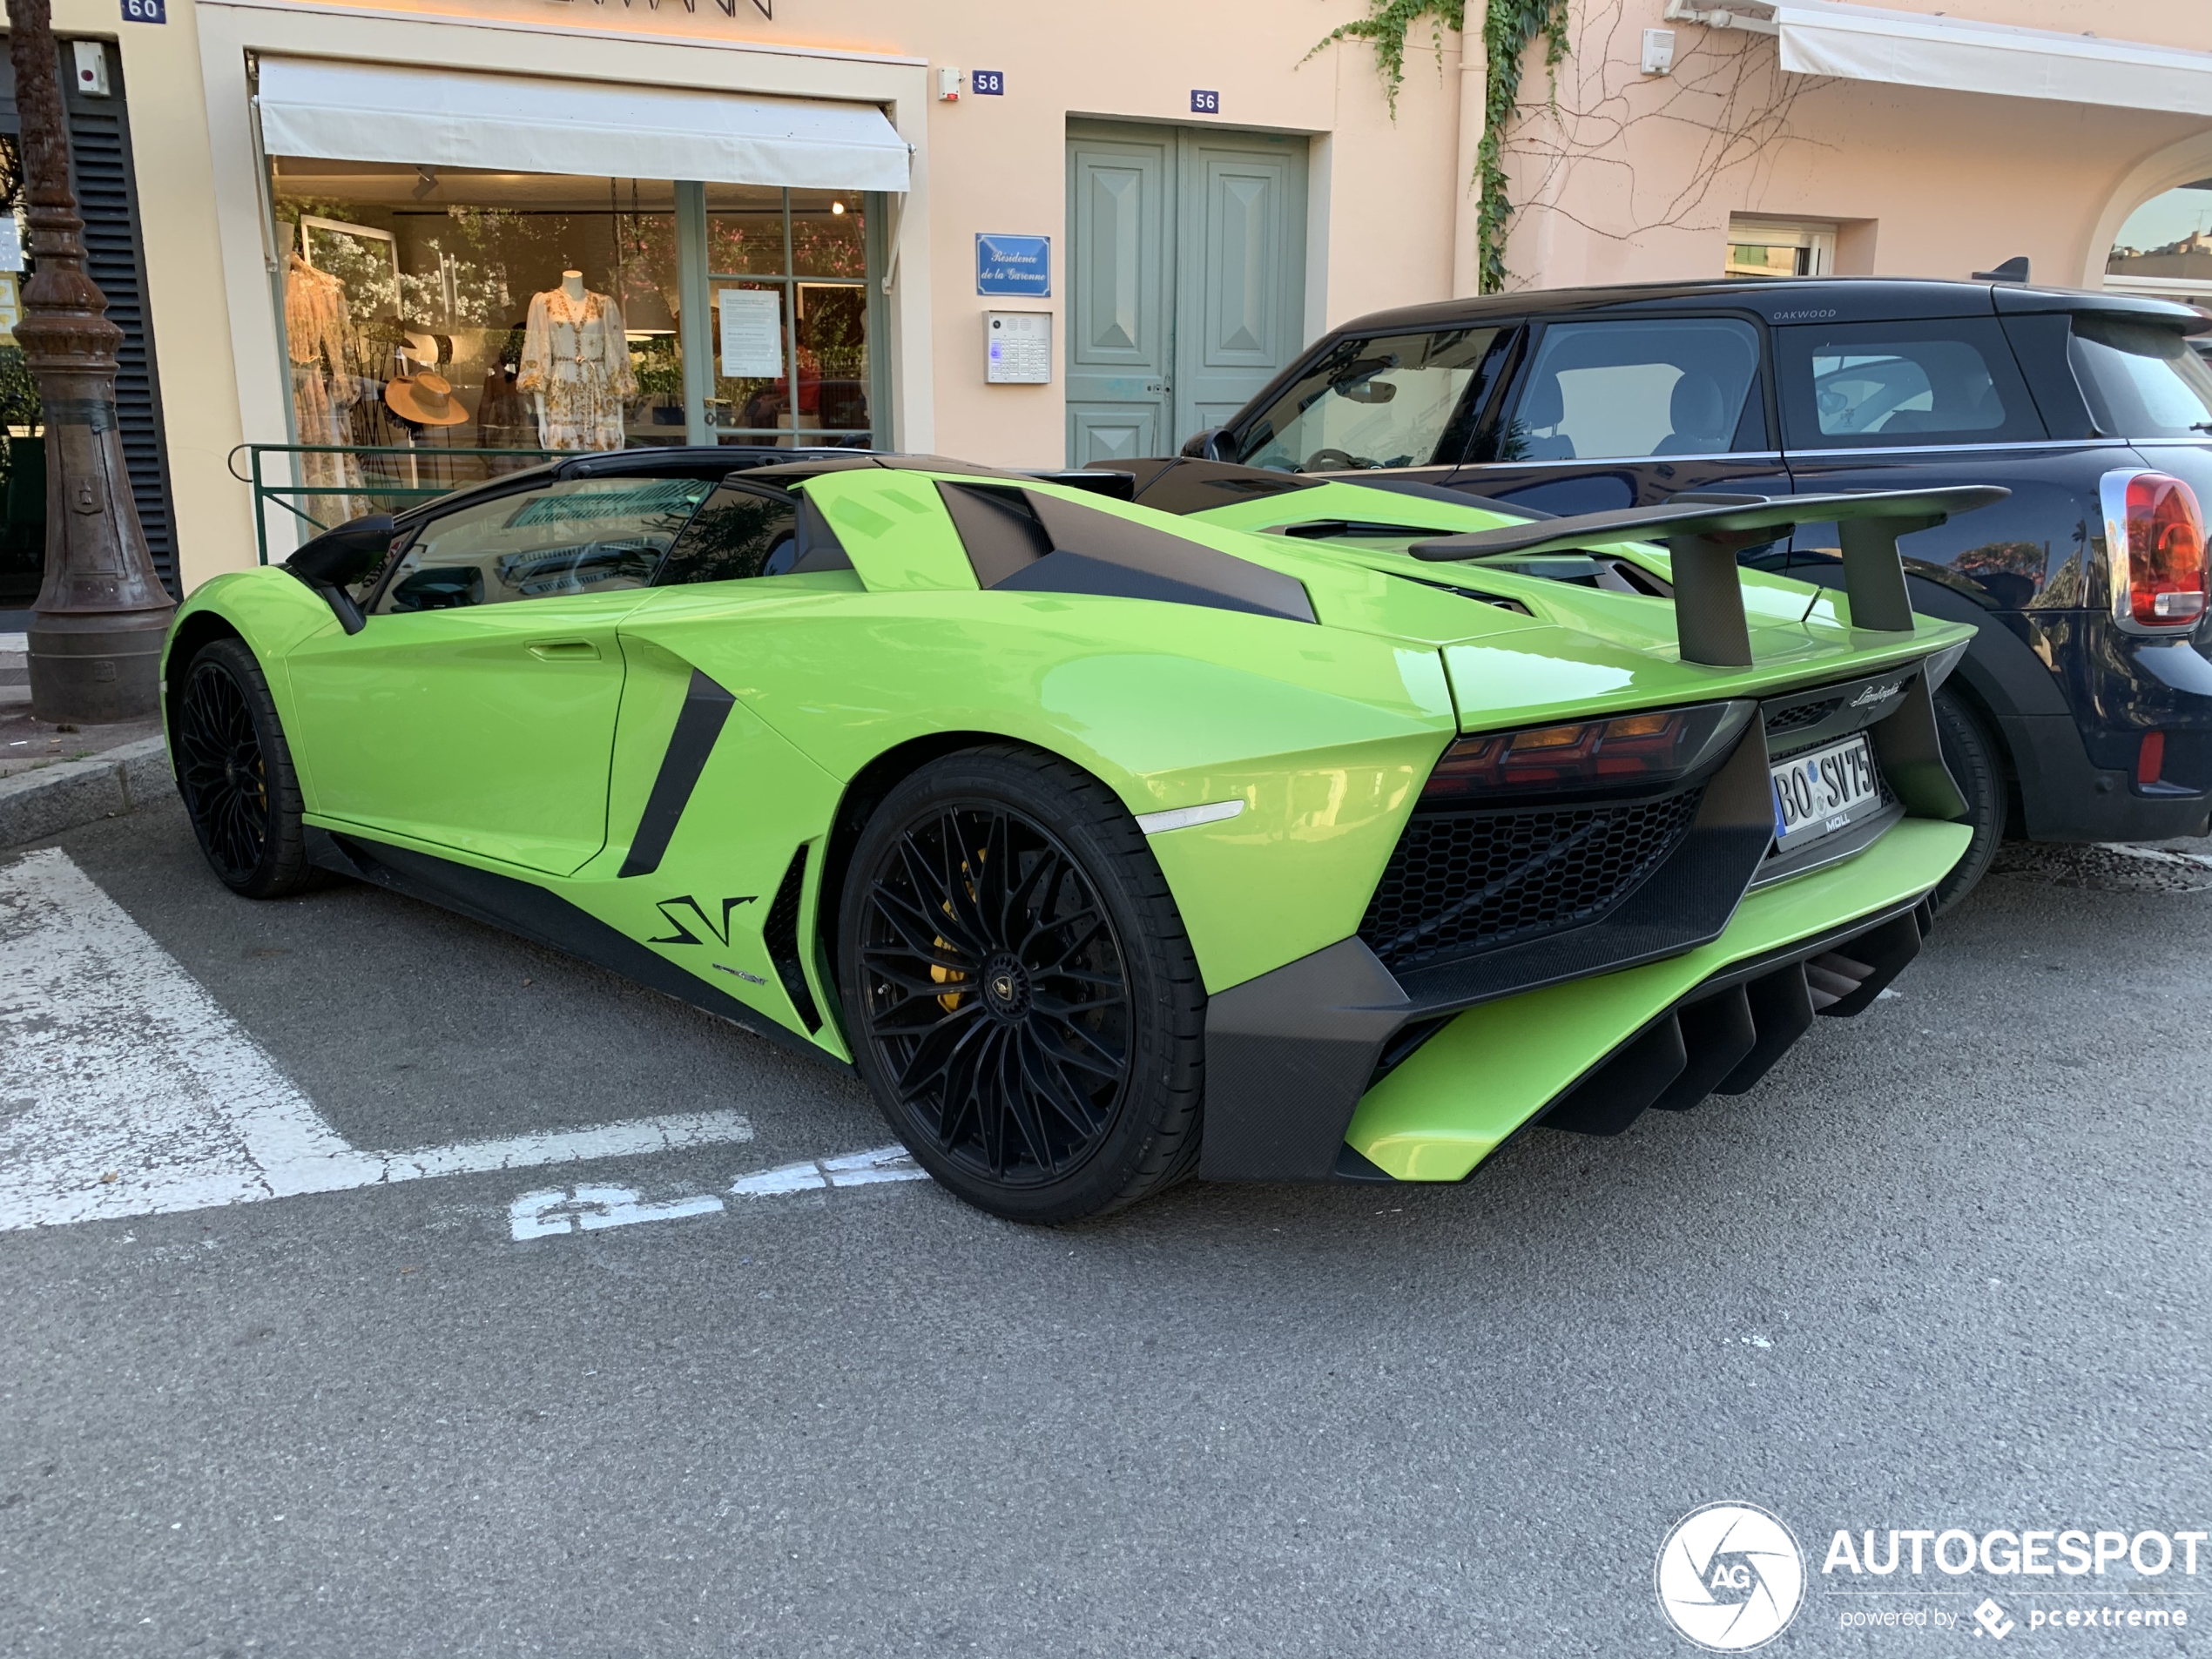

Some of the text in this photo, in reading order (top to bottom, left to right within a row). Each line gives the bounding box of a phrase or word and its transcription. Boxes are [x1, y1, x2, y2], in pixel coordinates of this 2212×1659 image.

[129, 0, 157, 17] 60
[978, 75, 999, 91] 58
[1196, 94, 1216, 109] 56
[991, 251, 1037, 264] Résidence
[981, 268, 993, 280] de
[995, 268, 1004, 280] la
[1773, 309, 1837, 320] OAKWOOD
[1774, 767, 1814, 826] BO
[1825, 814, 1851, 833] MOLL
[646, 894, 759, 948] SV
